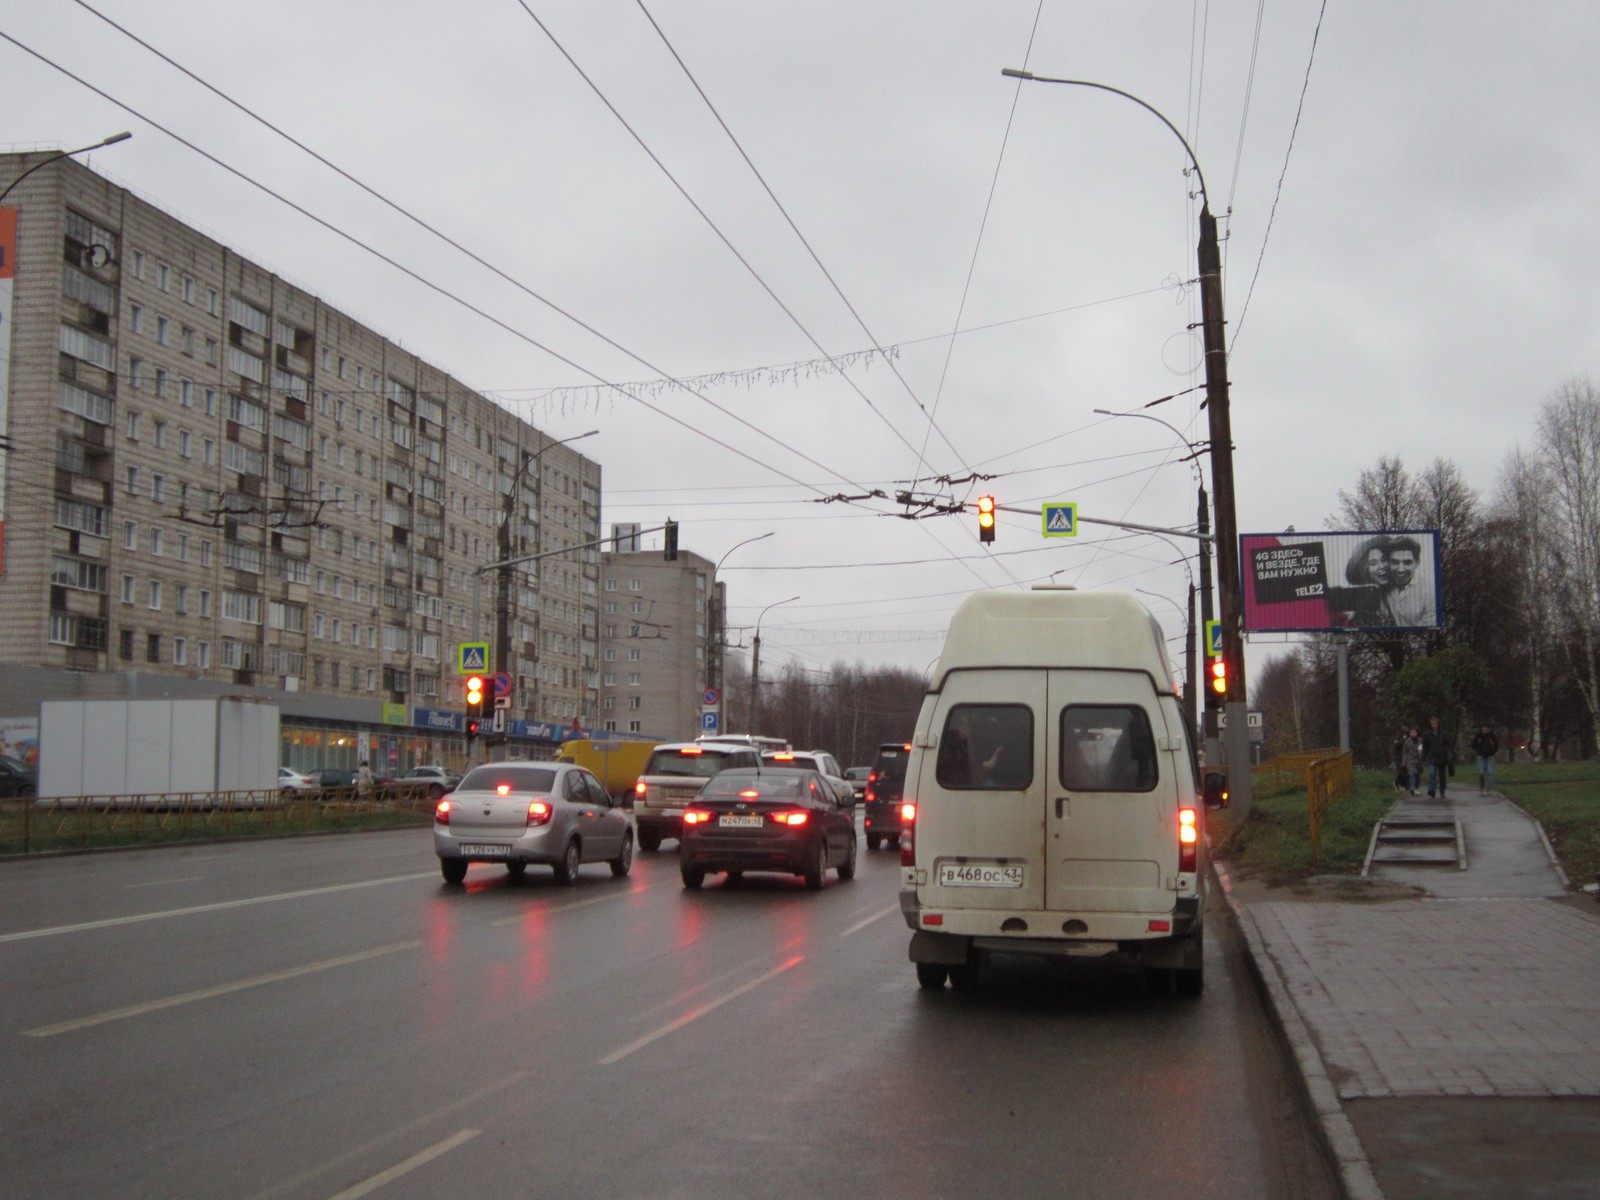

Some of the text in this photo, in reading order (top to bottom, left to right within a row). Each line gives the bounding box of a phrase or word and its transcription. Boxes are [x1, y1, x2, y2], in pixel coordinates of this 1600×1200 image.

[1255, 548, 1304, 560] 4G ЗДЕСЬ
[1256, 562, 1264, 571] И
[1301, 556, 1320, 566] ГДЕ
[1257, 566, 1318, 580] ВАМ НУЖНО
[1295, 583, 1325, 597] TELE2
[705, 715, 714, 727] P
[1004, 868, 1017, 879] 43
